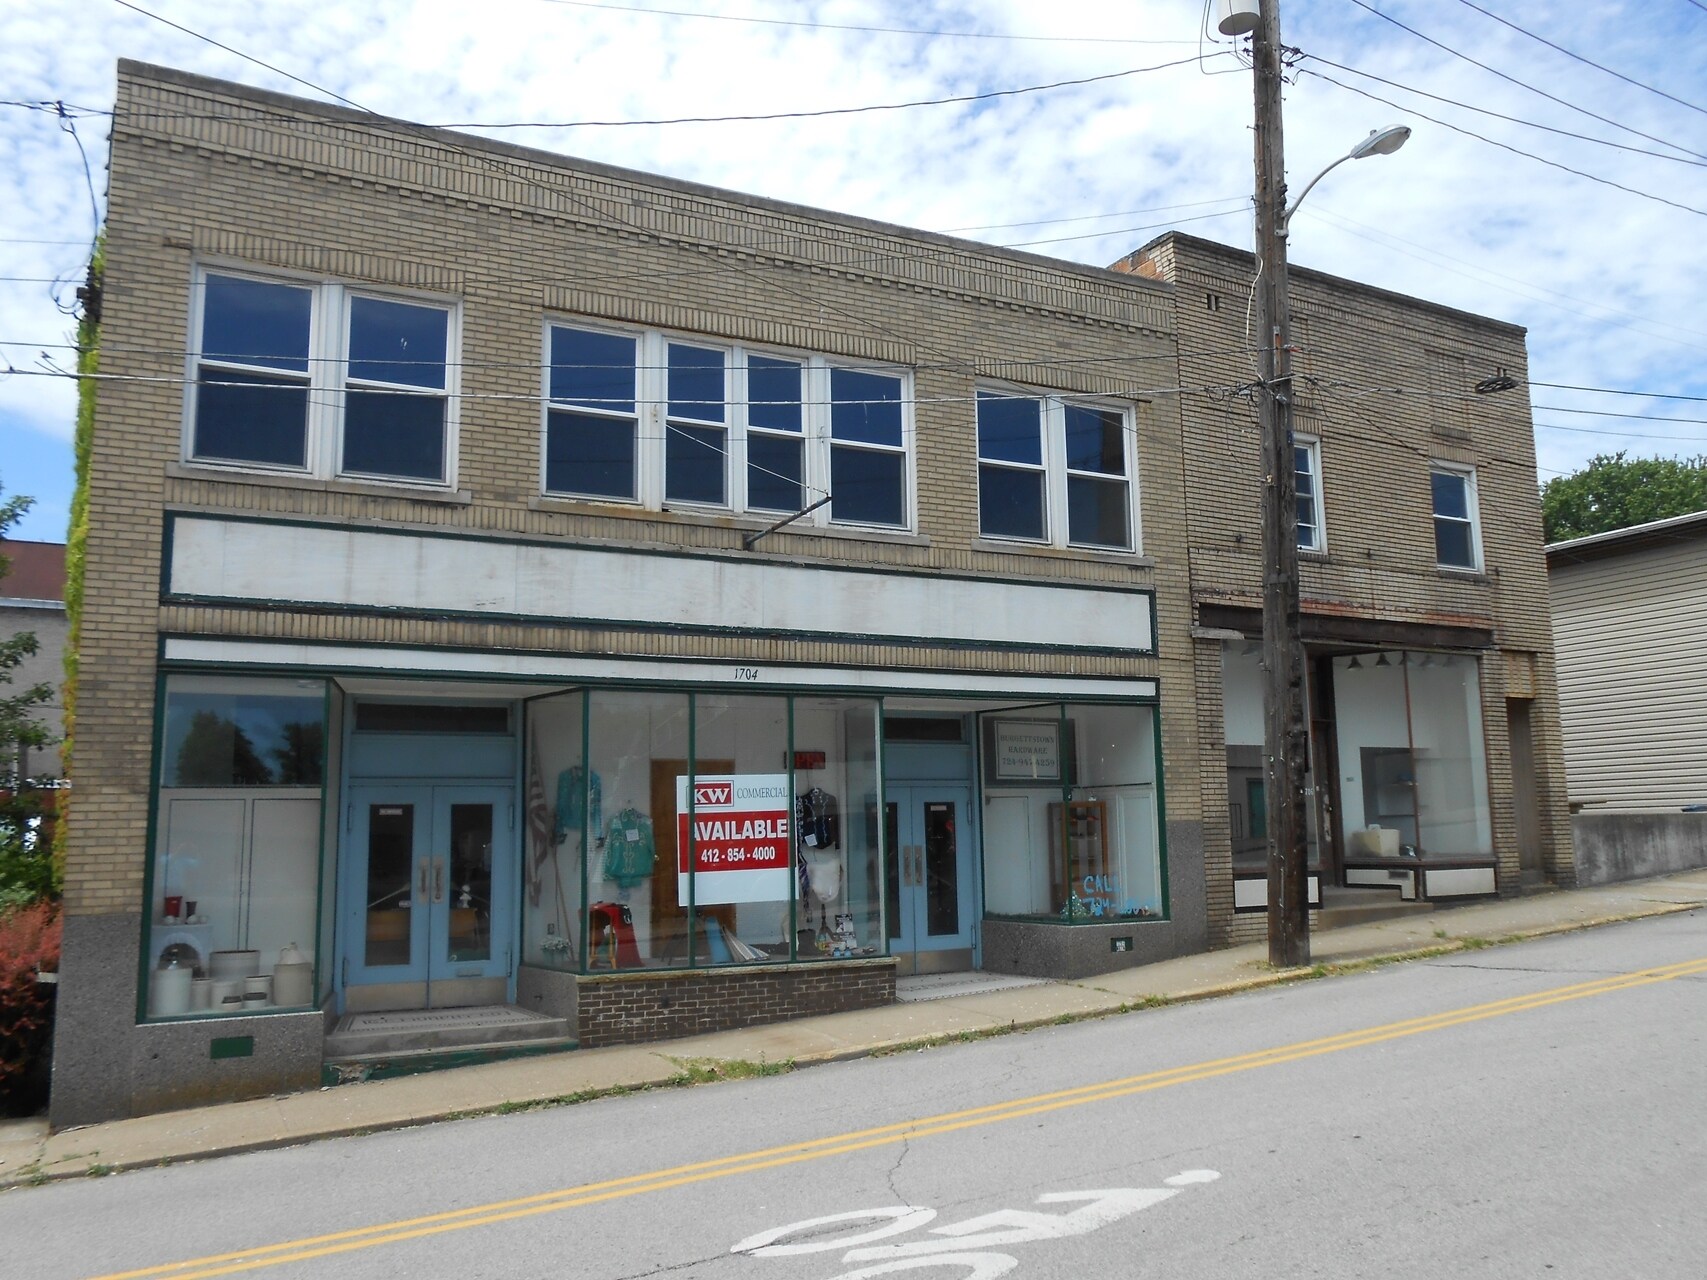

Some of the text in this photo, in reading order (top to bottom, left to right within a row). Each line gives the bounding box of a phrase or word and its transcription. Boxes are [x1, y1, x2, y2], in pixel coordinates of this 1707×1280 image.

[734, 668, 758, 680] 1704
[1008, 746, 1048, 755] HARDWARE
[694, 788, 730, 804] KW
[736, 787, 788, 799] COMMERCIAL
